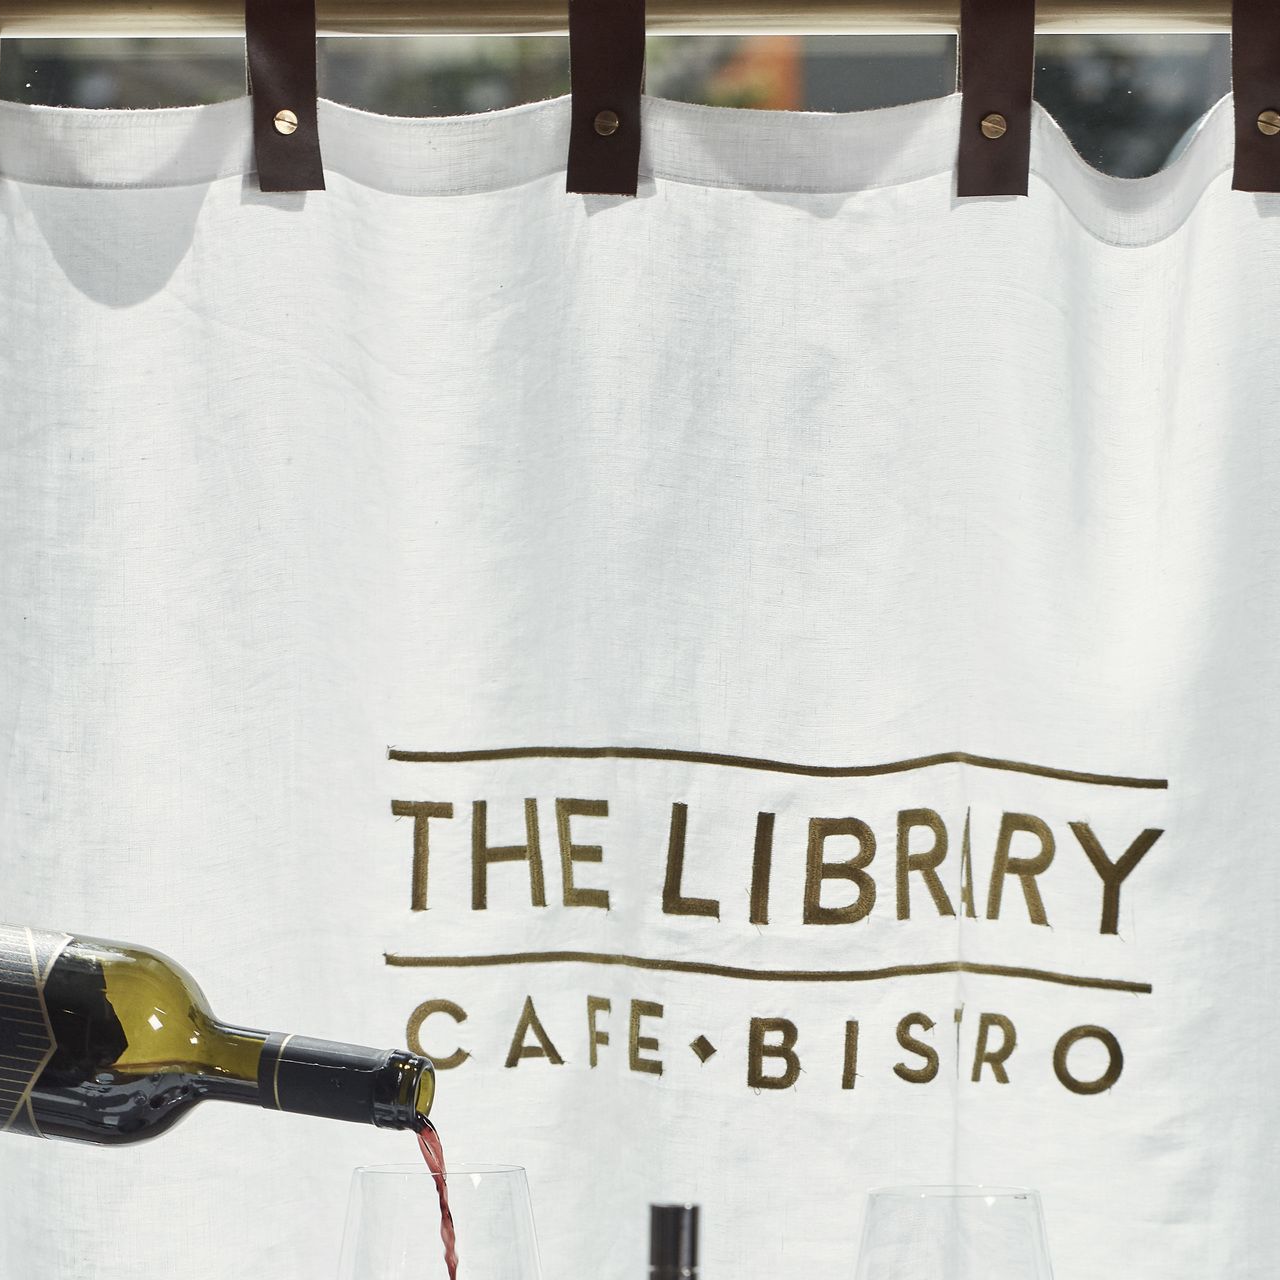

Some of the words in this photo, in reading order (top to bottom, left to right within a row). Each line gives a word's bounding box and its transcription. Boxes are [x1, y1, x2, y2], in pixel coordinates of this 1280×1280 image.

[391, 797, 610, 912] THE
[406, 996, 663, 1077] CAFE
[748, 1003, 1123, 1096] BISRO
